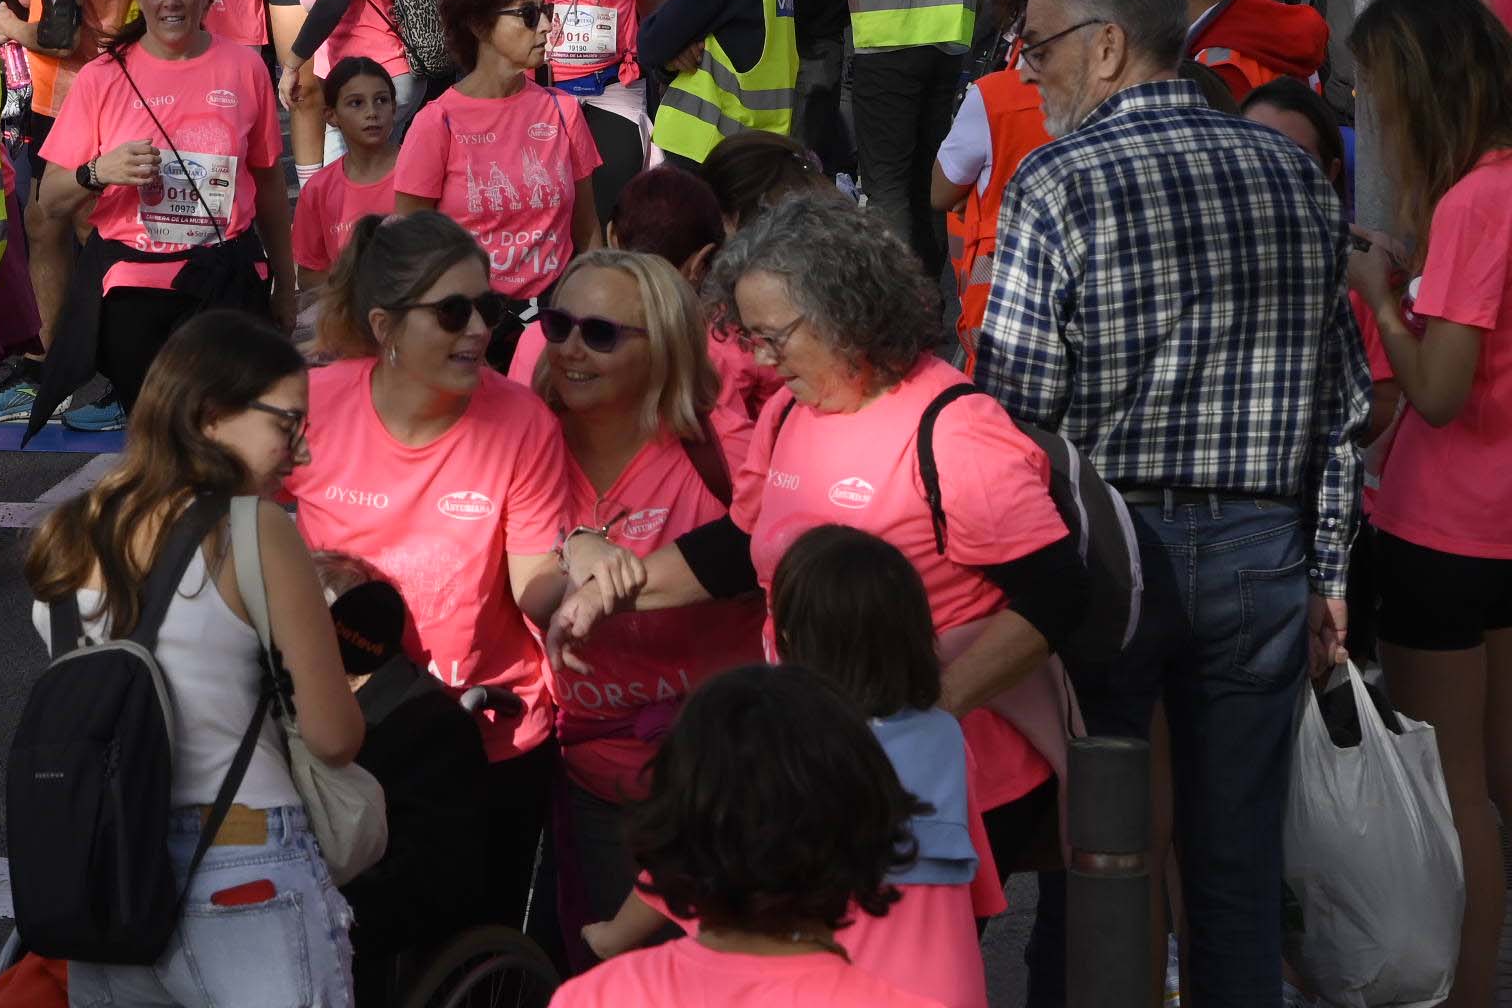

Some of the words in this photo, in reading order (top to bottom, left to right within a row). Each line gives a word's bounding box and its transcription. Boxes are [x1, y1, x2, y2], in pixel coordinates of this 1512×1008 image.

[567, 32, 590, 43] 016
[167, 187, 200, 202] 016
[170, 204, 196, 214] 10973
[490, 245, 560, 275] UMA
[325, 486, 388, 510] OYSHO
